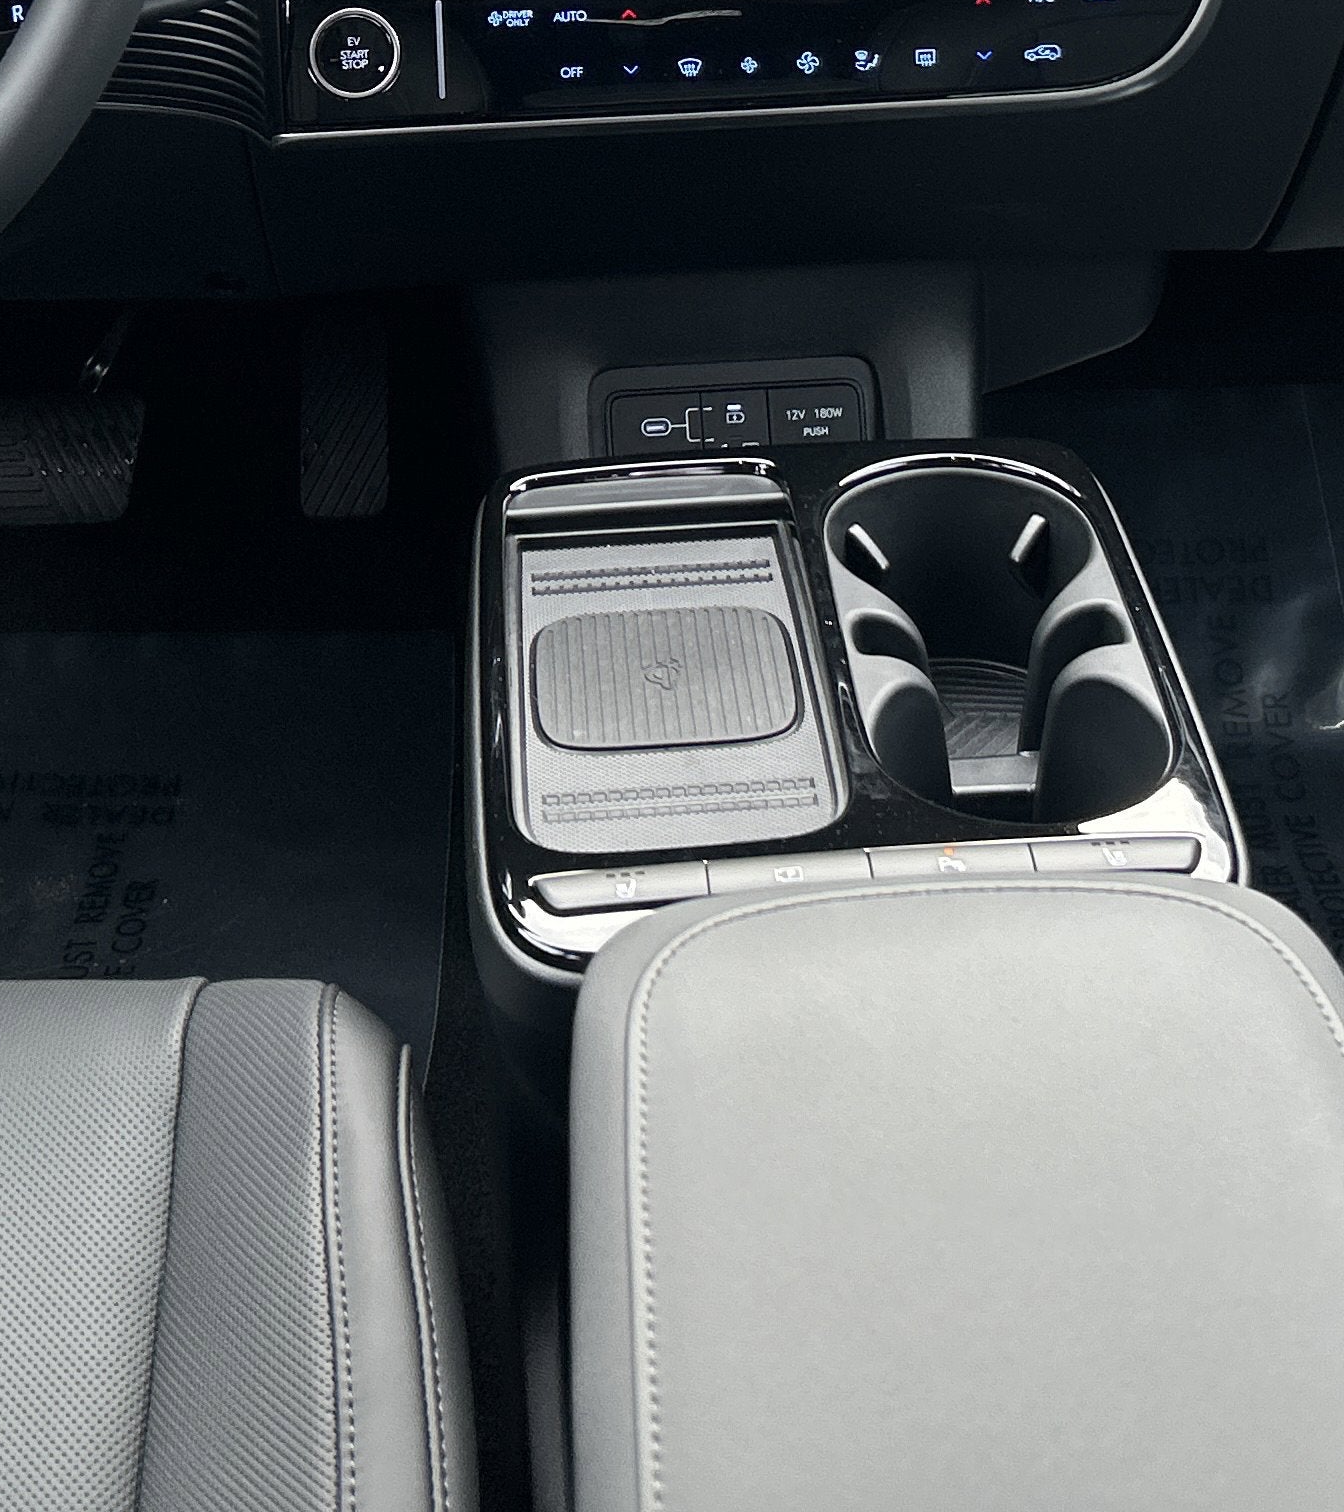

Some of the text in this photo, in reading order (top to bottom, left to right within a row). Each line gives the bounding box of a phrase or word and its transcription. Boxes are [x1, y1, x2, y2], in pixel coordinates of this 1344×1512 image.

[12, 4, 25, 23] R
[502, 9, 533, 21] DRIVER
[553, 10, 587, 24] AUTO
[505, 18, 532, 28] ONLY
[347, 36, 361, 47] EV
[340, 49, 369, 61] START
[341, 58, 369, 71] STOP
[559, 65, 584, 80] OFF
[785, 406, 843, 422] 12V 180W
[803, 426, 829, 437] PUSH
